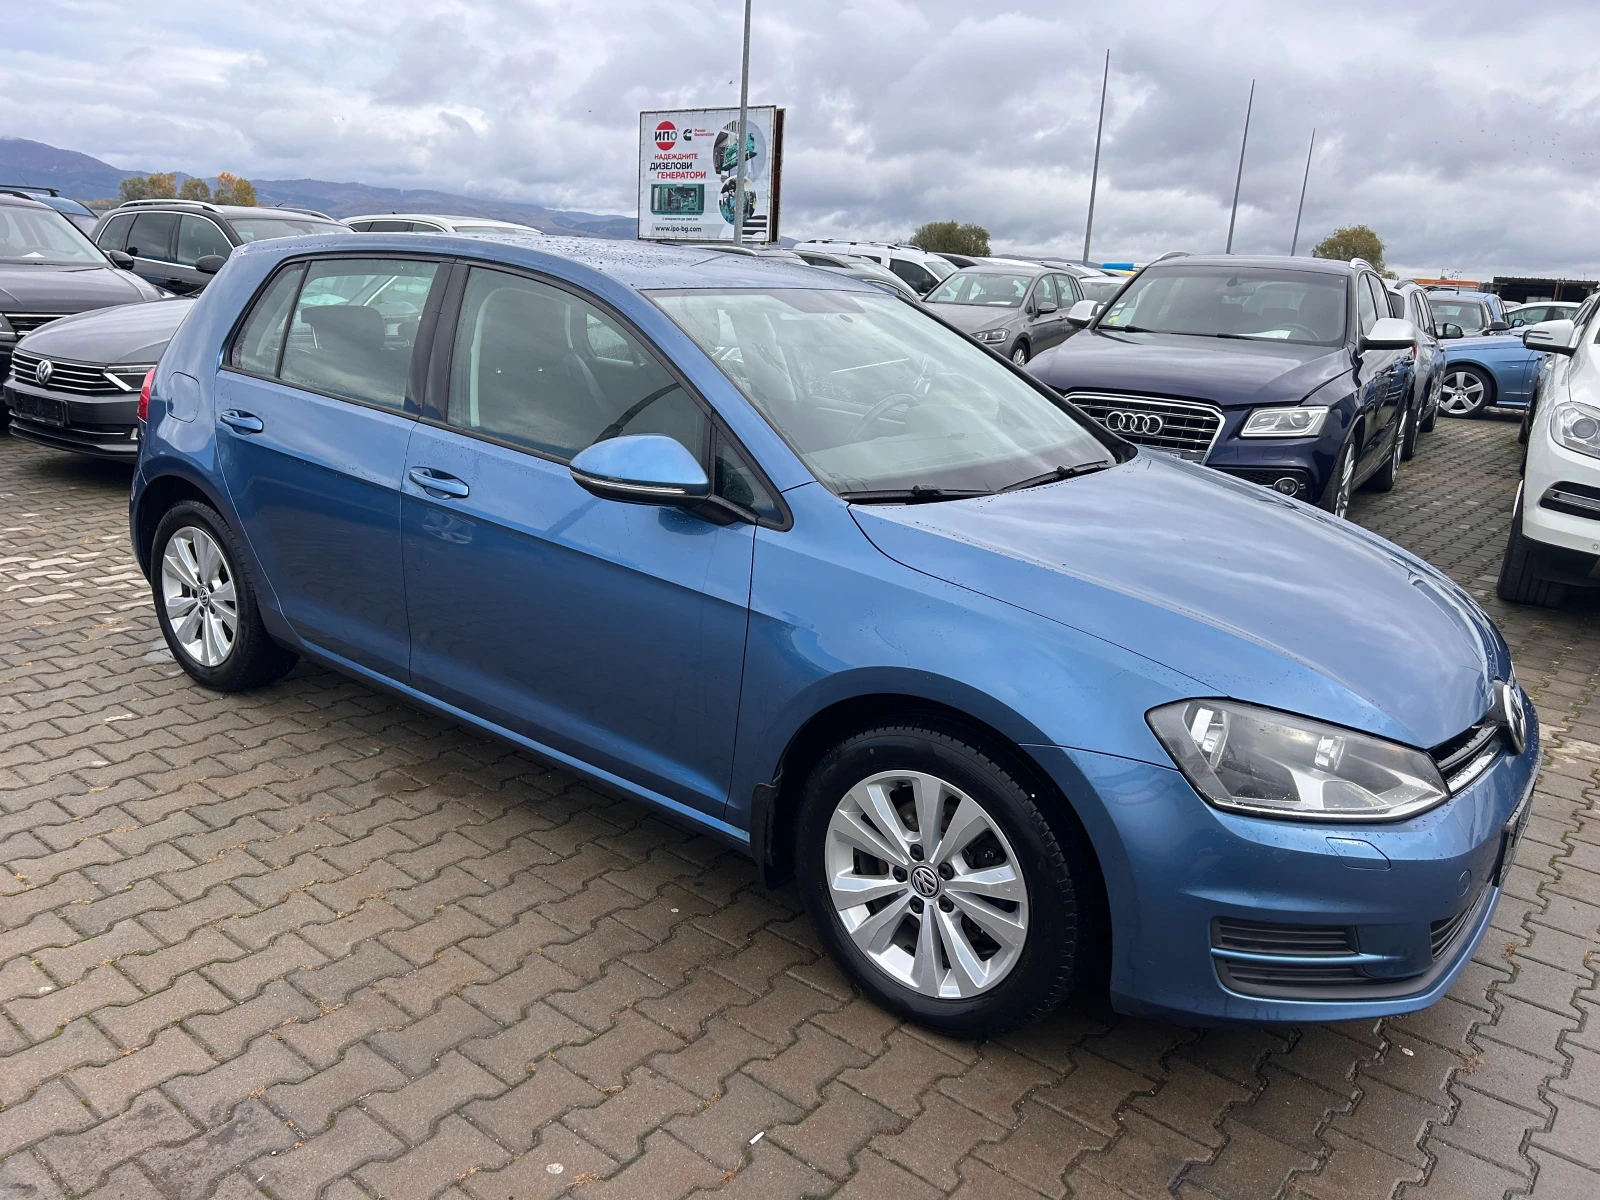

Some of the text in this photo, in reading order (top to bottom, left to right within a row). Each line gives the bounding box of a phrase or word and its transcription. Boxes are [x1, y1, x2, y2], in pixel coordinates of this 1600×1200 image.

[654, 131, 678, 141] ИПО
[650, 162, 692, 171] ДИЗЕЛОВИ
[657, 171, 706, 179] ГЕНЕРАТОРИ
[655, 225, 702, 233] www.ipo-bg.com
